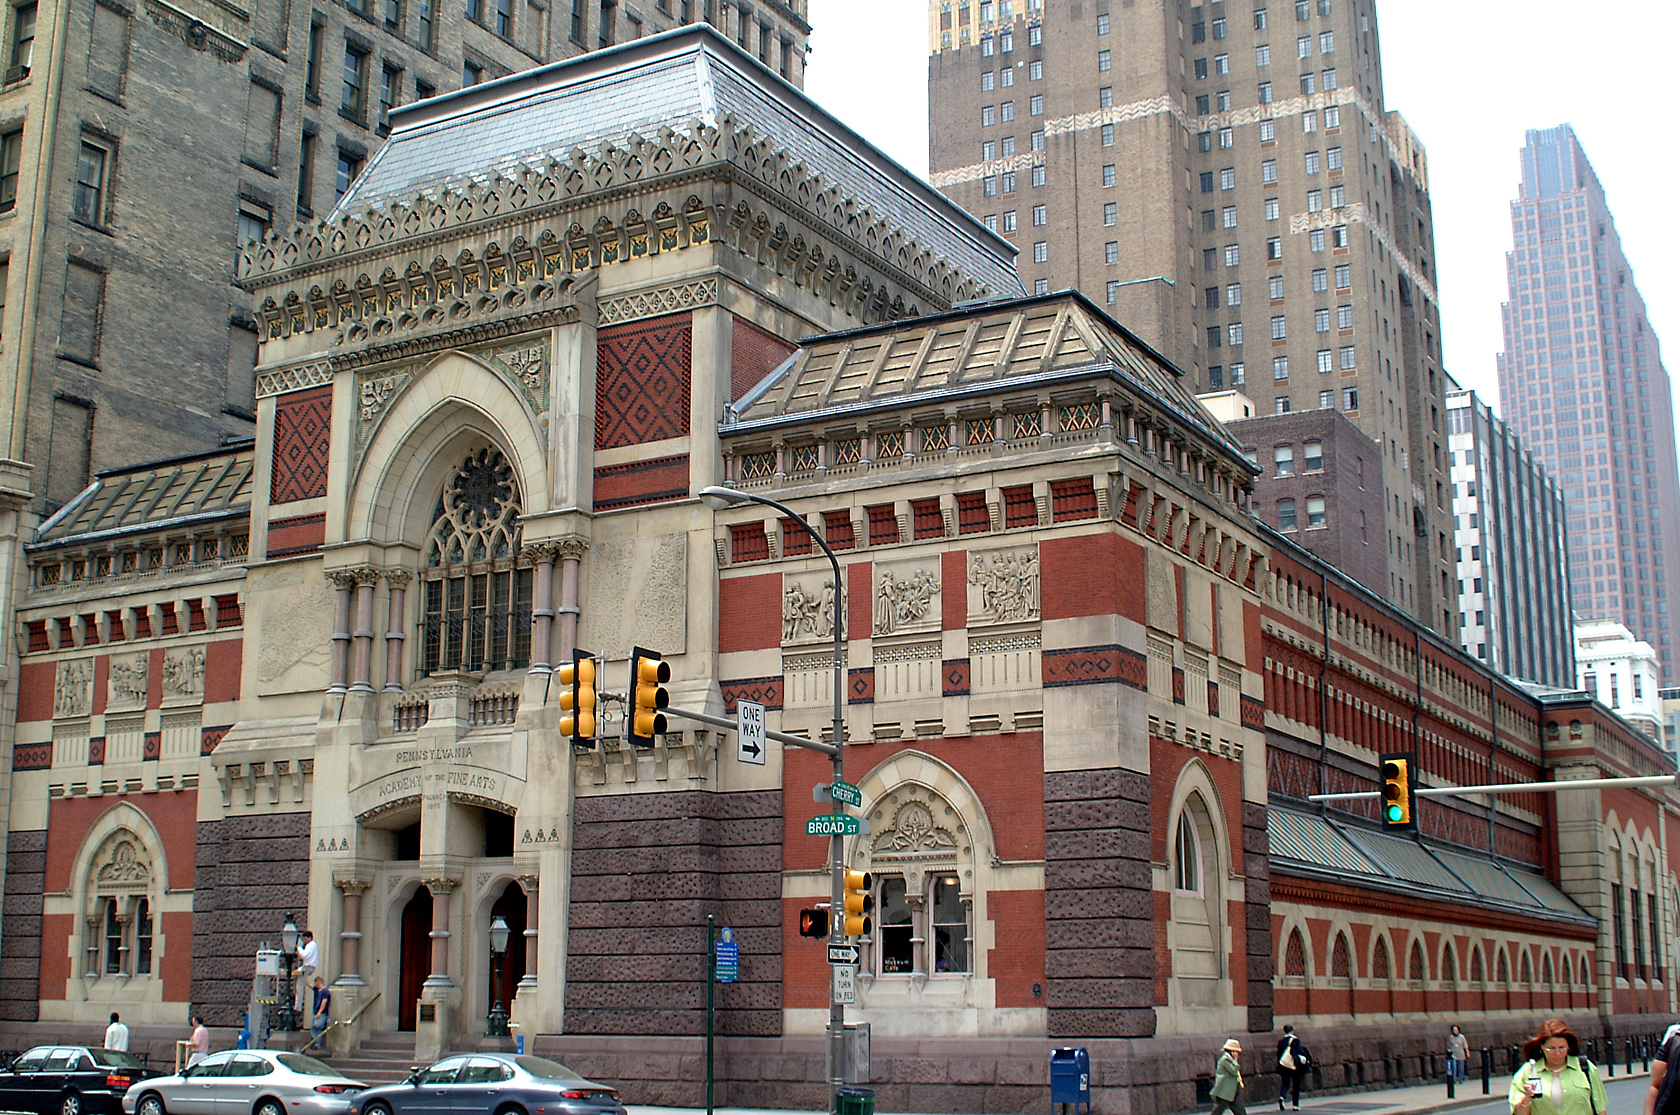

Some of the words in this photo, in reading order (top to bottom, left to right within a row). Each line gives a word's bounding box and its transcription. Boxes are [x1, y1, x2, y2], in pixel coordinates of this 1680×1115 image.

[743, 706, 760, 723] ONE
[742, 722, 761, 739] WAY
[396, 747, 473, 763] PENNSYLVANIA
[379, 775, 421, 797] ACADEMY
[447, 772, 468, 786] FINE
[470, 774, 496, 790] ARTS
[832, 786, 854, 803] CHERRY
[808, 822, 844, 834] BROAD
[848, 824, 856, 832] ST
[830, 950, 840, 958] ONE
[838, 980, 851, 988] TURN
[836, 992, 842, 1000] ON
[844, 992, 852, 1000] RED
